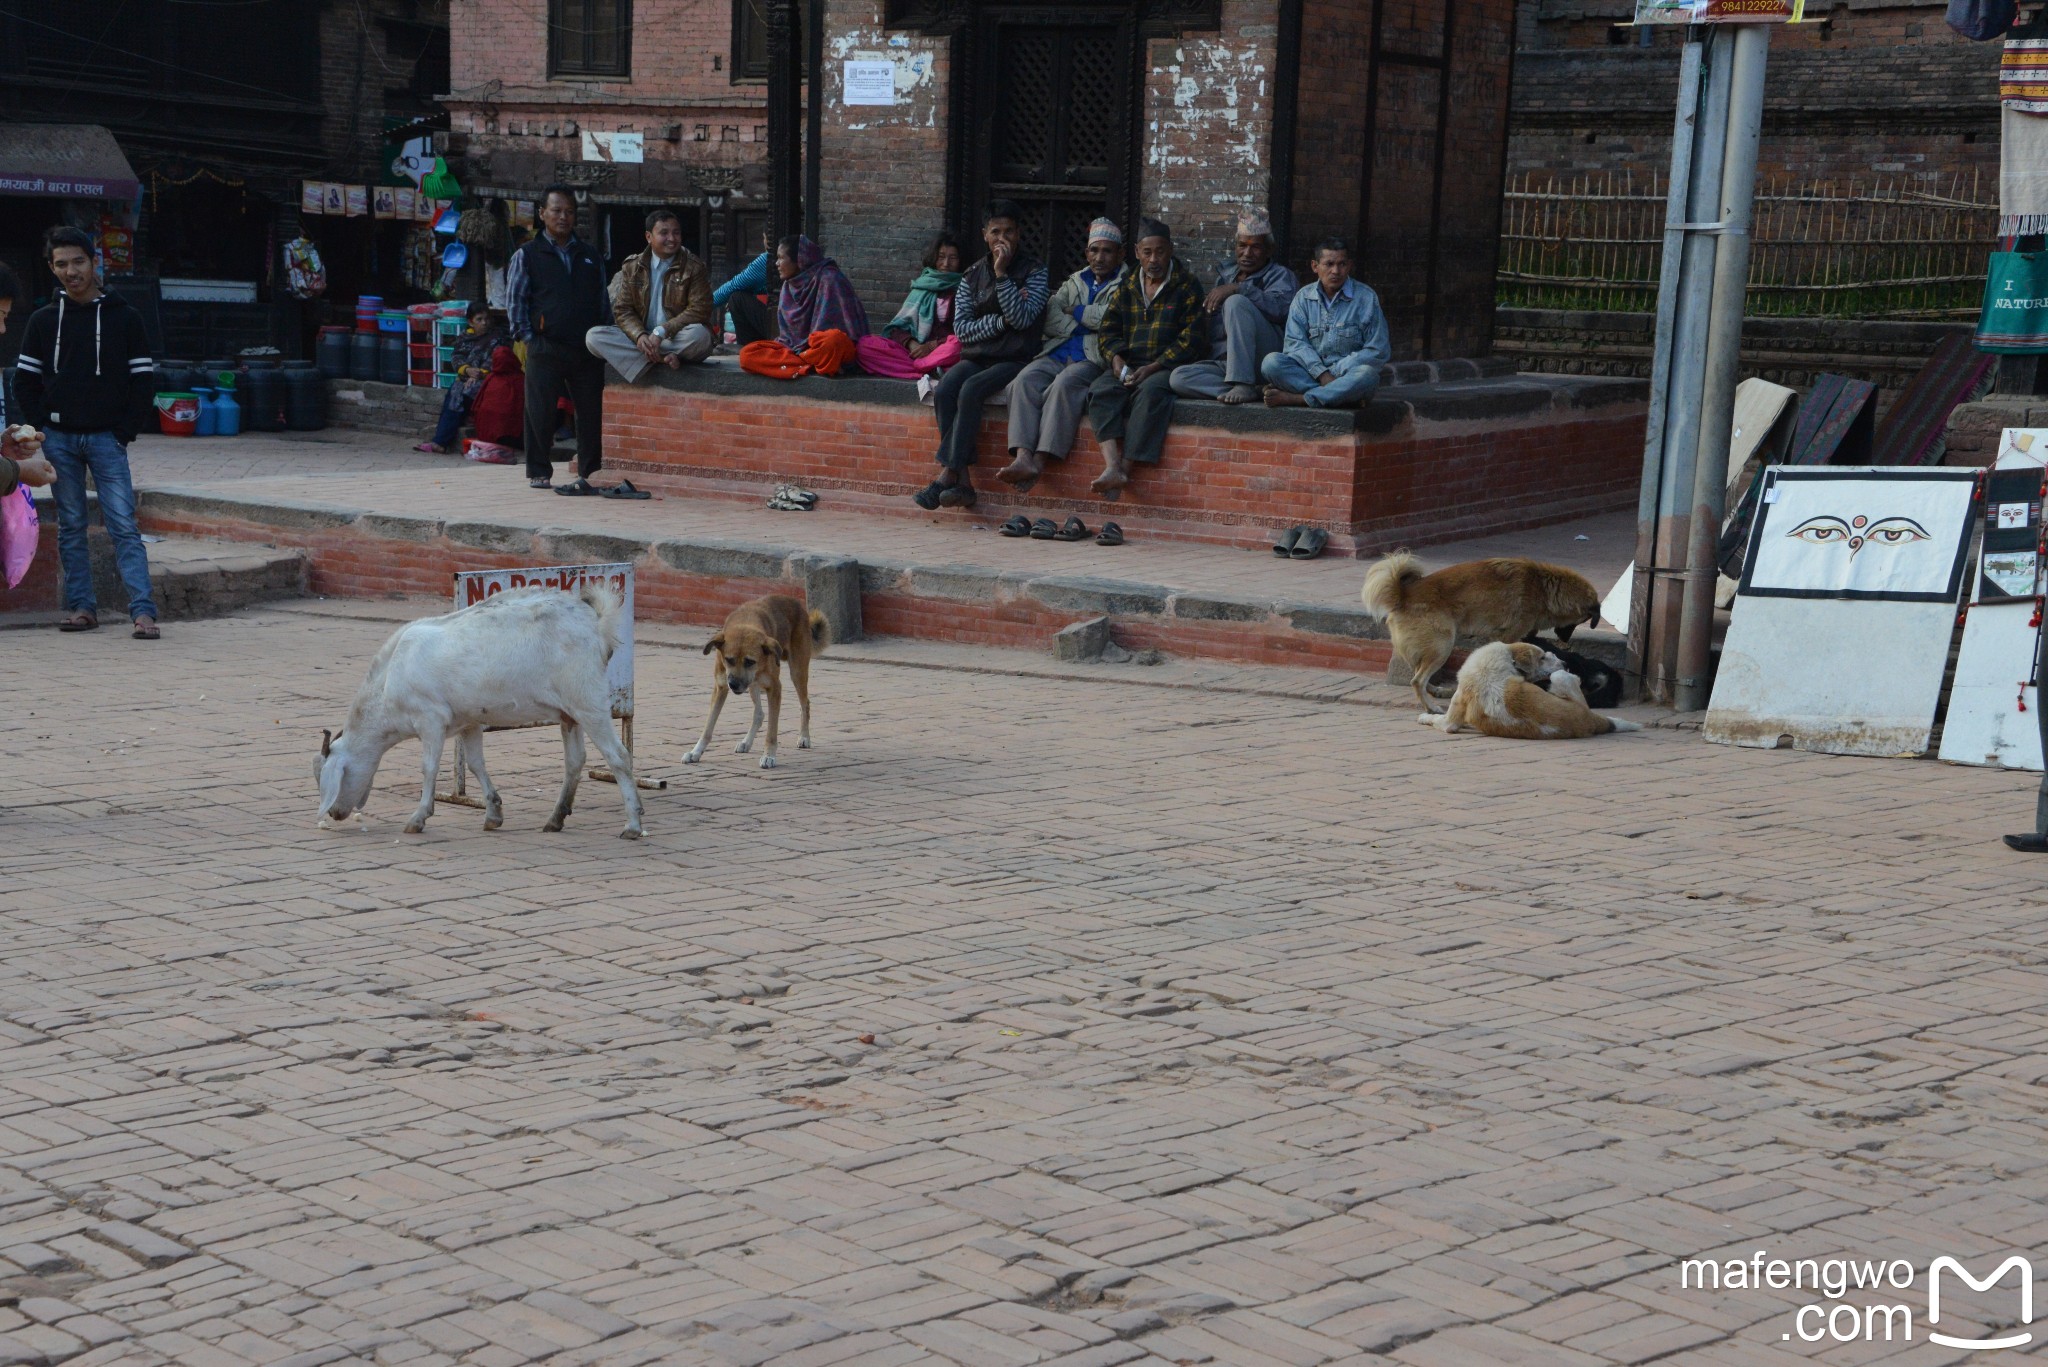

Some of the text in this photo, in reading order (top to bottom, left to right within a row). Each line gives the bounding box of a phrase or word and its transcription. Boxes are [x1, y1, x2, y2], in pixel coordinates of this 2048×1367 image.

[1721, 0, 1785, 12] 9841229227
[74, 183, 104, 195] पसल
[2004, 280, 2014, 291] I
